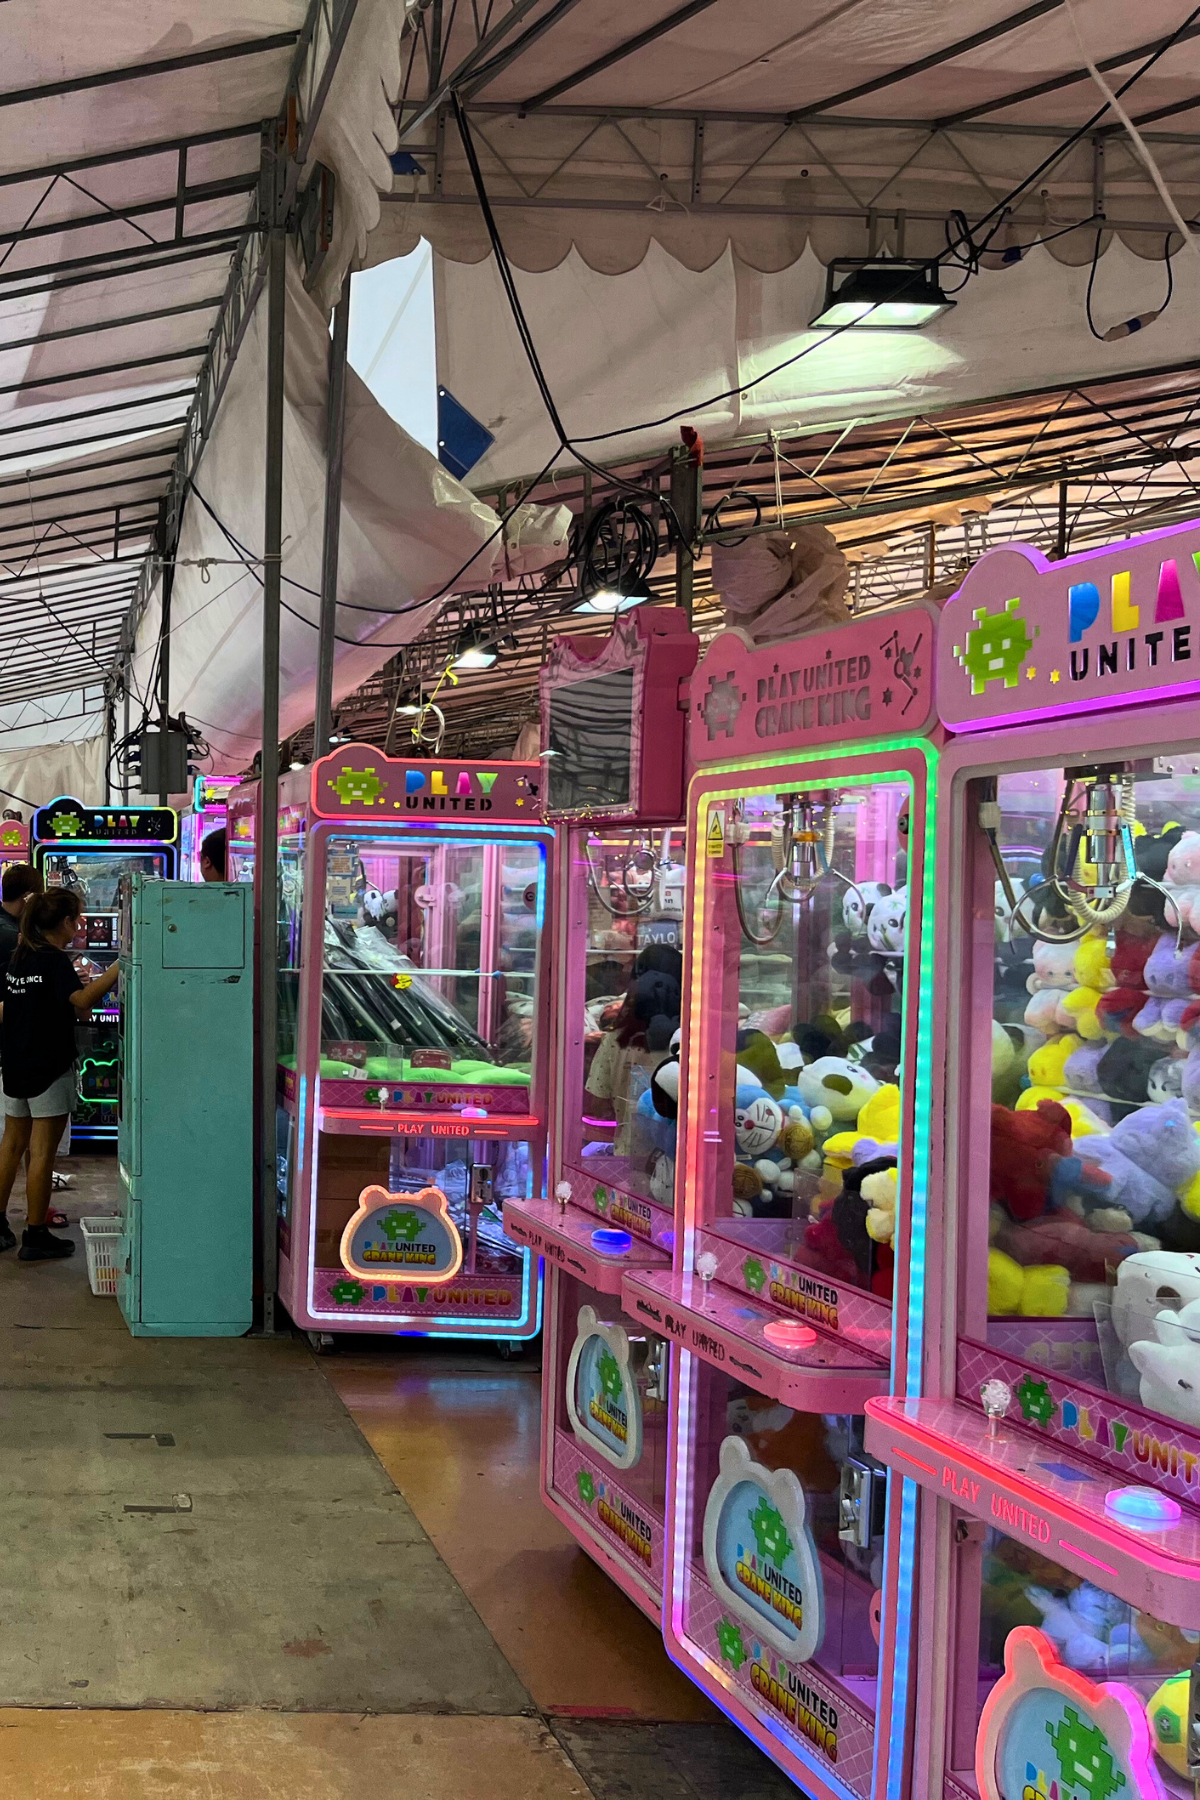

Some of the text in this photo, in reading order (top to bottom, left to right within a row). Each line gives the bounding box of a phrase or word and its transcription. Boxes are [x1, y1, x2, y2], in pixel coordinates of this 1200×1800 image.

[1069, 551, 1200, 643] PLA
[1069, 624, 1200, 681] UNITE
[757, 655, 871, 703] PLAY UNITED
[755, 686, 871, 738] CRANE KING
[405, 770, 498, 795] PLAY
[94, 815, 140, 827] PLAY
[405, 796, 492, 811] UNITED
[394, 1090, 492, 1104] PLAY UNITED
[398, 1123, 469, 1135] PLAY UNITED
[362, 1250, 436, 1265] CRANE KING
[364, 1241, 436, 1253] PLAY UNITED
[373, 1285, 512, 1306] PLAY UNITED
[769, 1281, 838, 1330] CRANE KING
[799, 1276, 838, 1305] UNITED
[607, 1400, 627, 1428] UNITE
[1062, 1399, 1200, 1485] PLAY UNIT
[621, 1502, 651, 1541] UNITED
[942, 1466, 1051, 1544] PLAY UNITED
[735, 1561, 803, 1630] CRANE KING
[764, 1563, 802, 1605] UNITED
[750, 1662, 837, 1763] CRANE KING
[788, 1671, 838, 1729] UNITED
